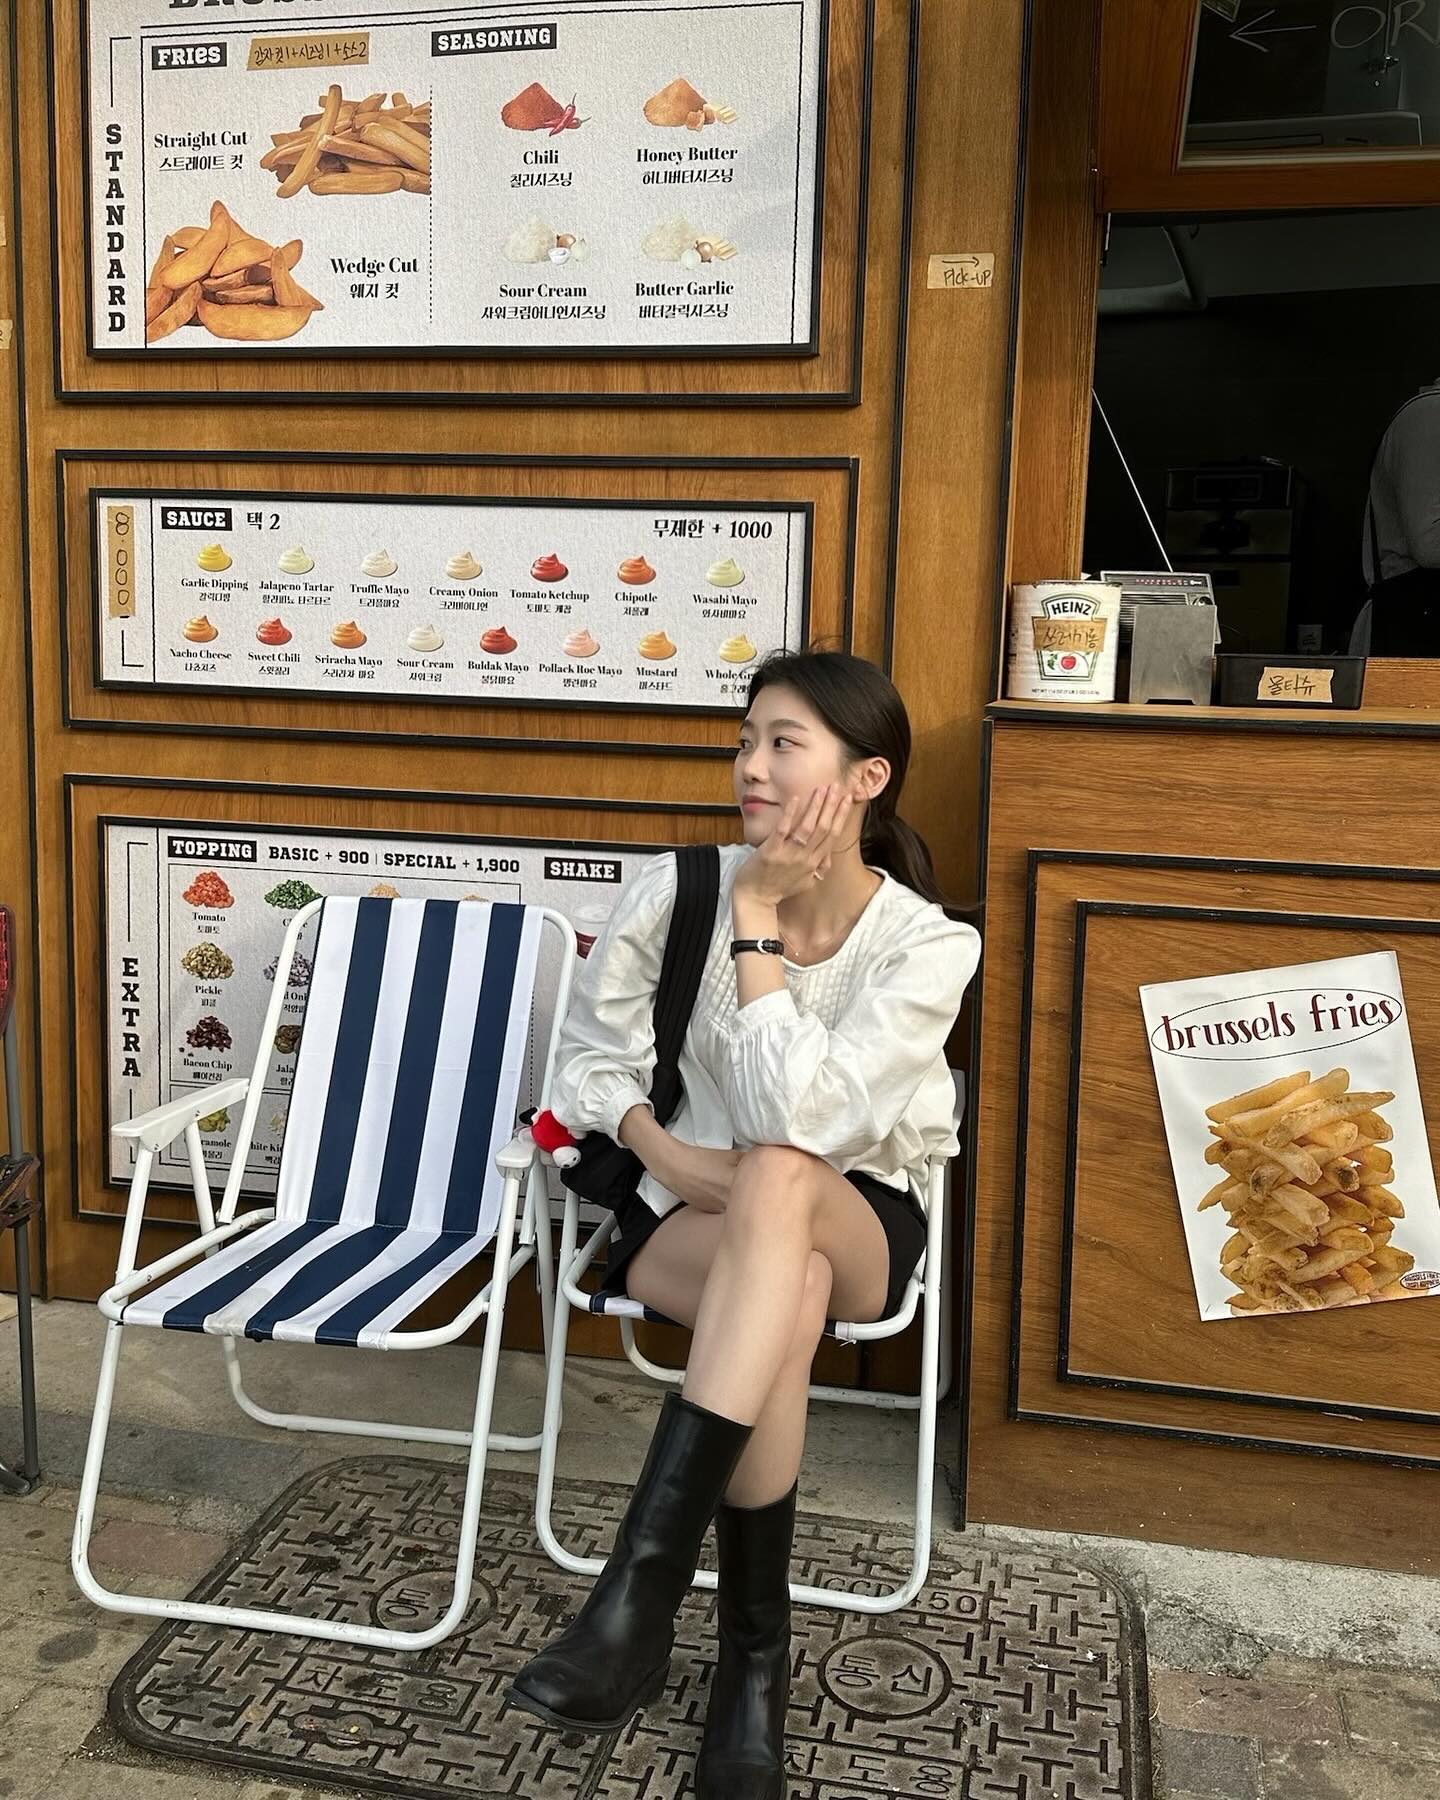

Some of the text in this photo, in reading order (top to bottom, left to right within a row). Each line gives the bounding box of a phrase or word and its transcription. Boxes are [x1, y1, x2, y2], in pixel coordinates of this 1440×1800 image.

[437, 27, 551, 51] SEASONING
[155, 131, 247, 151] Straight Cut
[160, 154, 242, 171] 스트레이트 컷
[524, 150, 558, 165] Chili
[637, 147, 737, 165] Honey Butter
[510, 172, 572, 188] 칠리시즈닝
[643, 168, 733, 184] 허니버터시즈닝
[105, 123, 126, 332] STANDARD
[330, 257, 418, 278] Wedge Cut
[351, 283, 398, 298] 웨지 컷
[500, 284, 586, 297] Sour Cream
[636, 281, 733, 296] Butter Garlic
[481, 305, 605, 319] 사워크림어니언시즈닝
[639, 304, 728, 318] 버터갈릭시즈닝
[166, 511, 227, 528] SAUCE
[247, 512, 280, 530] 택 2
[654, 519, 704, 538] 무제한
[730, 521, 772, 538] 1000
[181, 578, 248, 591] Garlic Dipping
[303, 583, 334, 591] Tartar
[350, 584, 409, 596] Truffle Mayo
[430, 587, 498, 599] Creamy Onion
[512, 590, 589, 603] Tomato Ketchup
[615, 592, 657, 604] Chipotle
[693, 594, 757, 607] Wasabi Mayo
[1051, 600, 1093, 617] HEINZ
[200, 650, 231, 659] Cheese
[248, 652, 300, 662] Sweet Chili
[315, 655, 356, 664] Sriracha
[397, 659, 453, 668] Sour Cream
[468, 661, 502, 670] Buldak
[539, 664, 574, 673] Pollack
[637, 667, 677, 677] Mustard
[705, 669, 739, 680] Whole
[172, 839, 253, 859] TOPPING
[269, 846, 318, 861] BASIC
[339, 851, 369, 864] 900
[384, 853, 456, 869] SPECIAL
[477, 858, 519, 873] 1,900
[549, 860, 616, 880] SHAKE
[192, 912, 225, 921] Tomato
[196, 986, 222, 995] Pickle
[290, 991, 308, 1002] Oni
[121, 957, 142, 1078] EXTRA
[1161, 993, 1394, 1051] brussels fries
[184, 1058, 232, 1074] Bacon Chip
[275, 1063, 296, 1075] Jala
[832, 1654, 934, 1697] 통신
